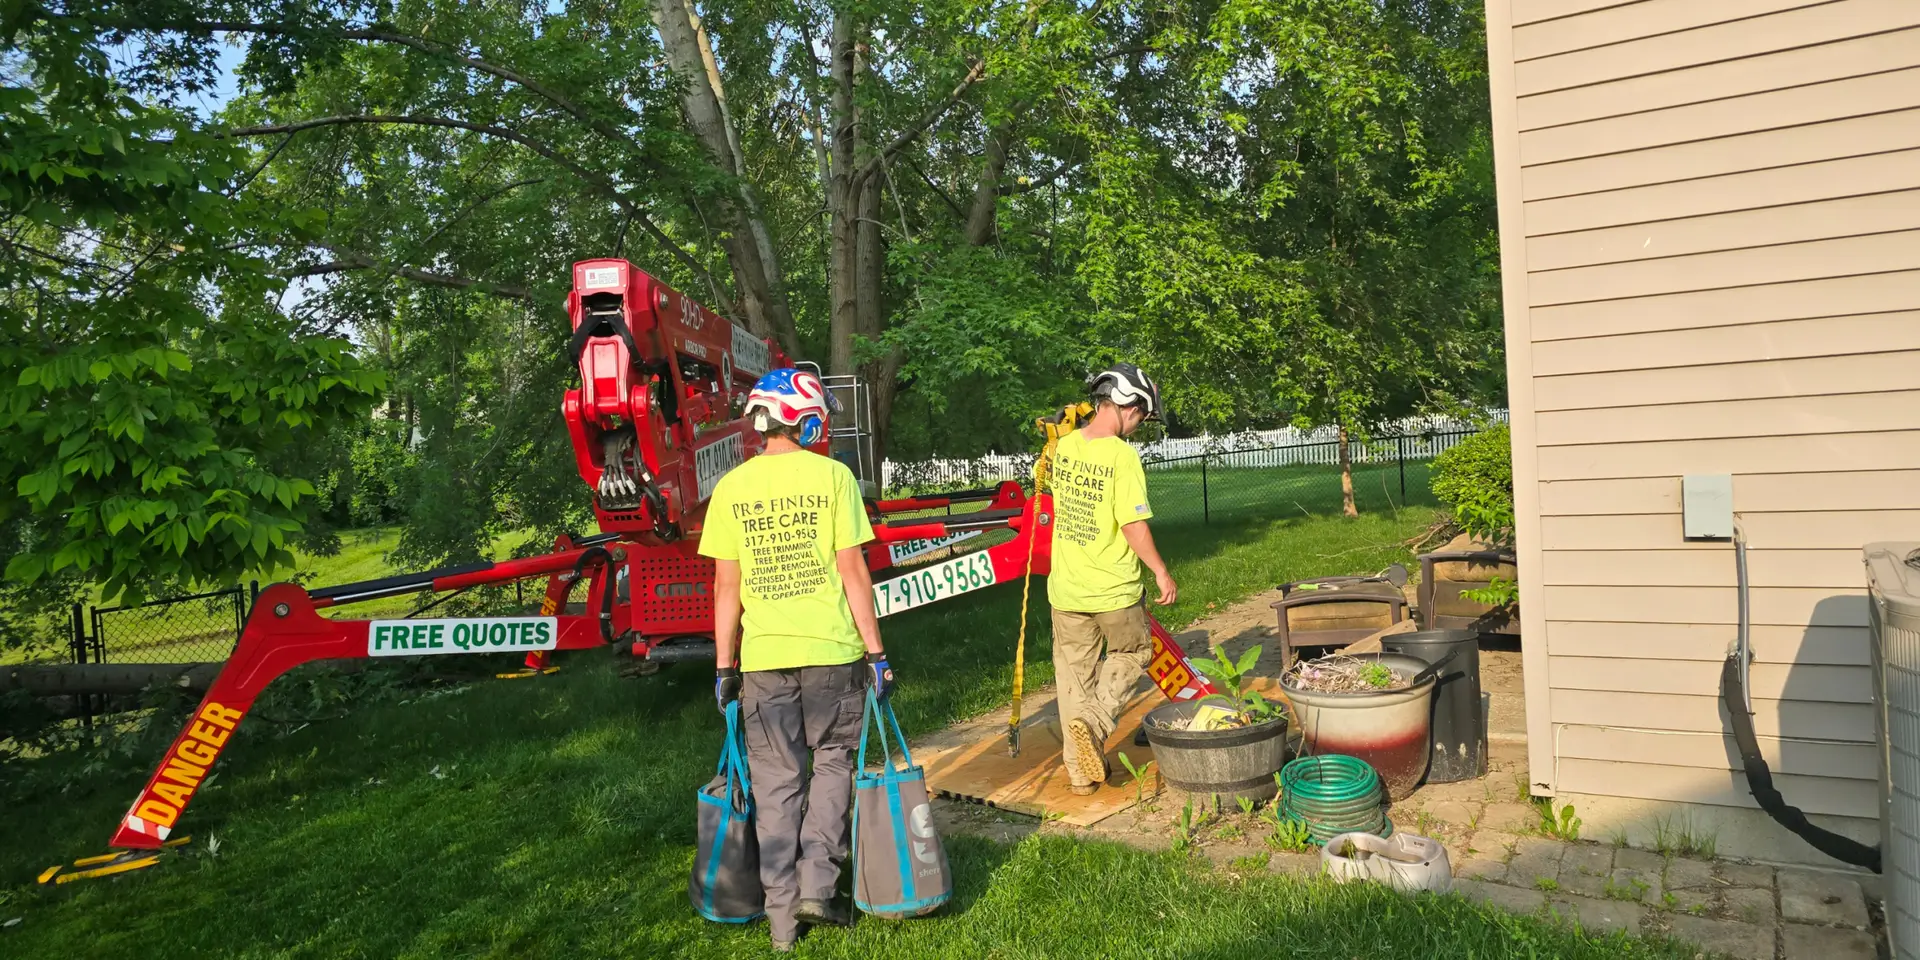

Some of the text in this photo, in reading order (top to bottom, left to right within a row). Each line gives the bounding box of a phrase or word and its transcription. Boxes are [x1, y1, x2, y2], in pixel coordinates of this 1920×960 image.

[1073, 460, 1114, 478] FINISH
[1075, 475, 1104, 491] CARE
[770, 495, 828, 512] FINISH
[742, 512, 818, 533] TREE CARE
[752, 541, 813, 557] TREE TRIMMING
[893, 537, 928, 559] FREE
[754, 551, 814, 565] TREE REMOVAL
[751, 559, 820, 576] STUMP REMOVAL
[745, 574, 786, 586] LICENSED
[796, 567, 828, 579] INSURED
[751, 577, 826, 593] VETERAN OWNED
[771, 588, 816, 600] OPERATED
[374, 621, 551, 651] FREE QUOTES
[136, 701, 243, 827] DANGER
